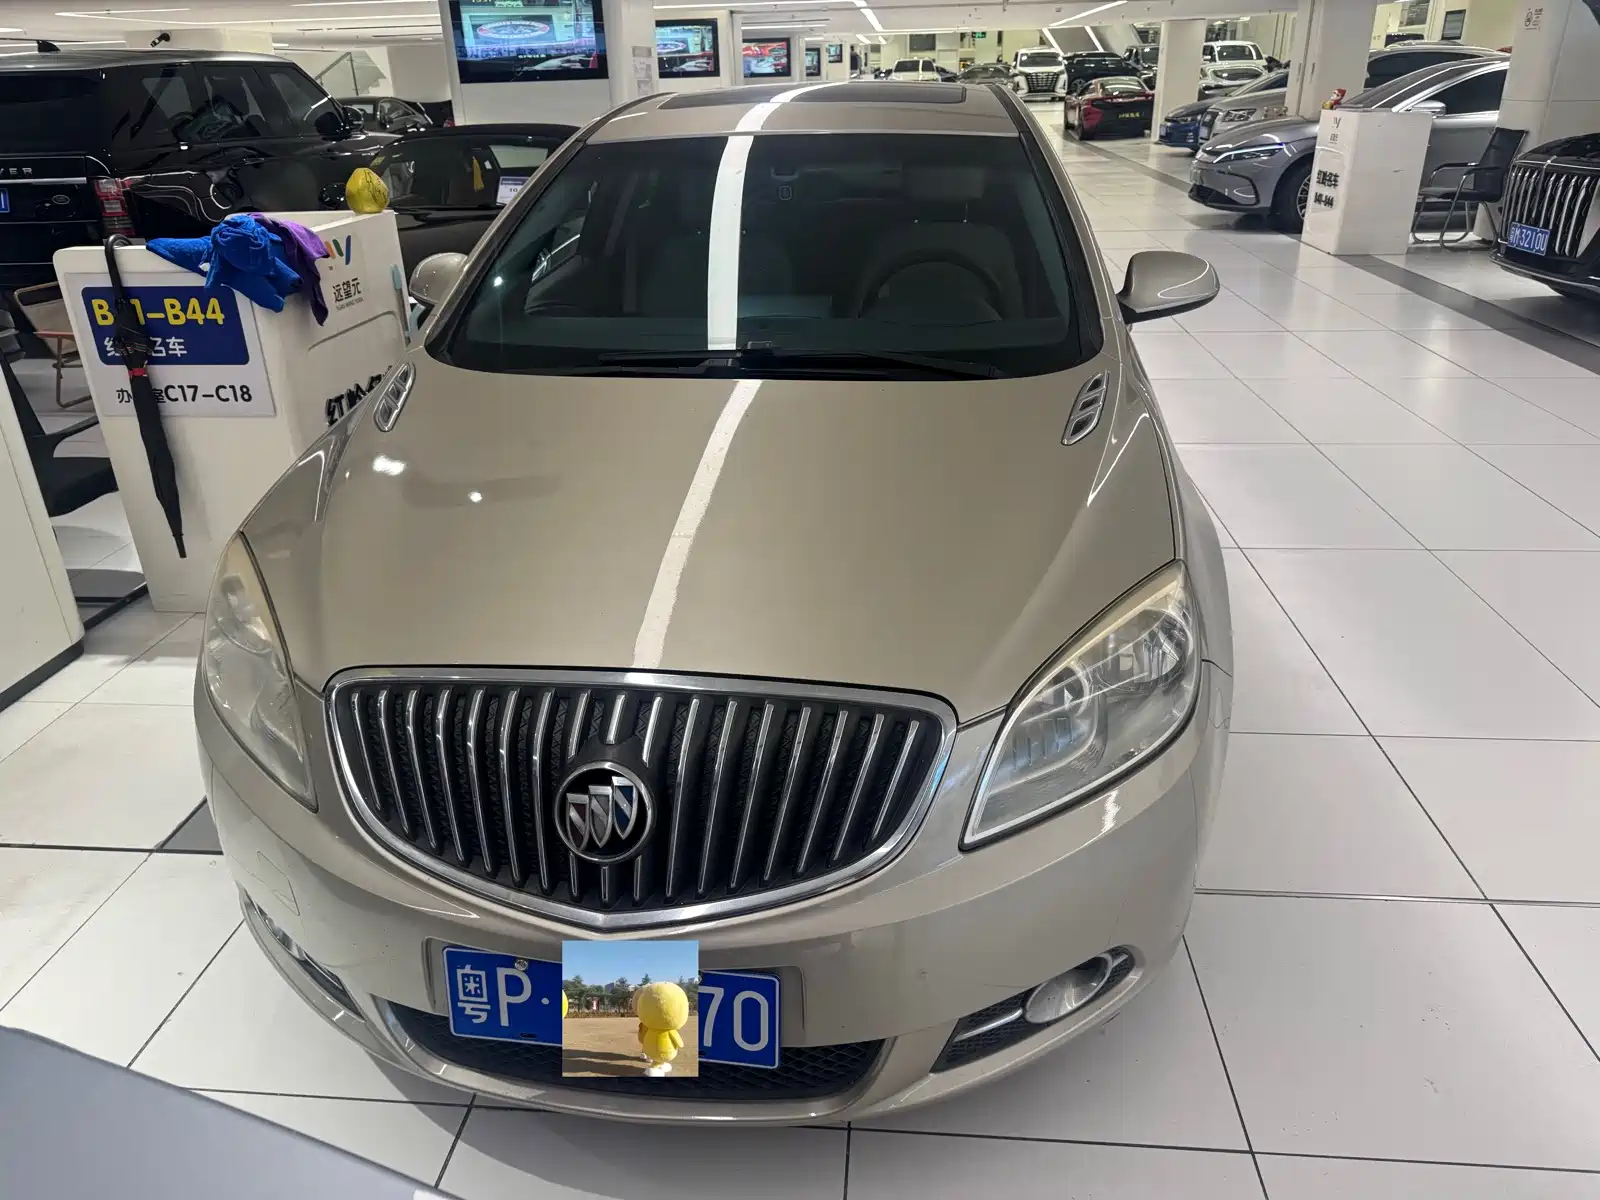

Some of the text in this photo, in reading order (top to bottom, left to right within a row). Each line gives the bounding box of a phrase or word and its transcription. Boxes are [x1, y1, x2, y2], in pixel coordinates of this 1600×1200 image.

[332, 277, 362, 303] 远望元
[91, 297, 225, 326] B1-B44
